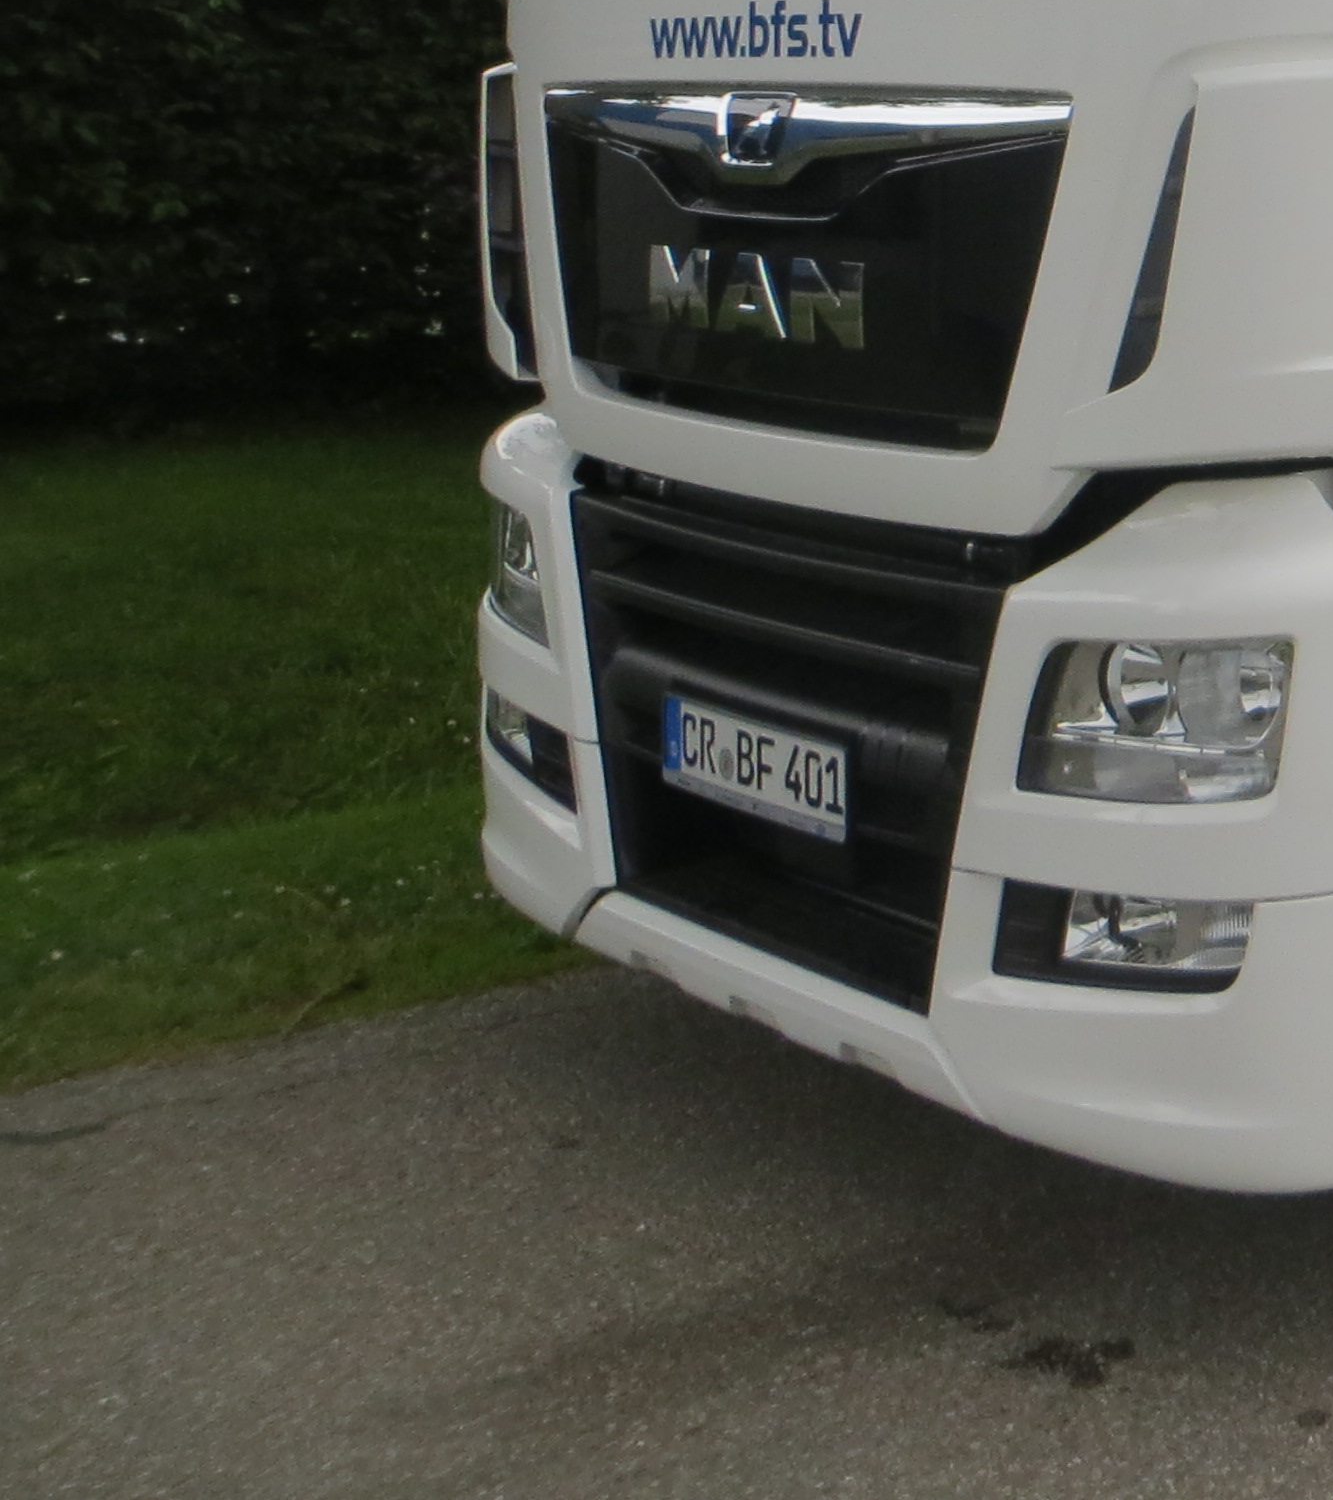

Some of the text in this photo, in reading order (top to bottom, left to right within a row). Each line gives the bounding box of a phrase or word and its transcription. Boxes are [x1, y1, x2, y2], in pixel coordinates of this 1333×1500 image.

[651, 0, 862, 58] www.bfs.tv
[650, 245, 865, 350] MAN
[683, 712, 716, 774] CR
[737, 730, 775, 790] BF
[785, 745, 842, 814] 401
